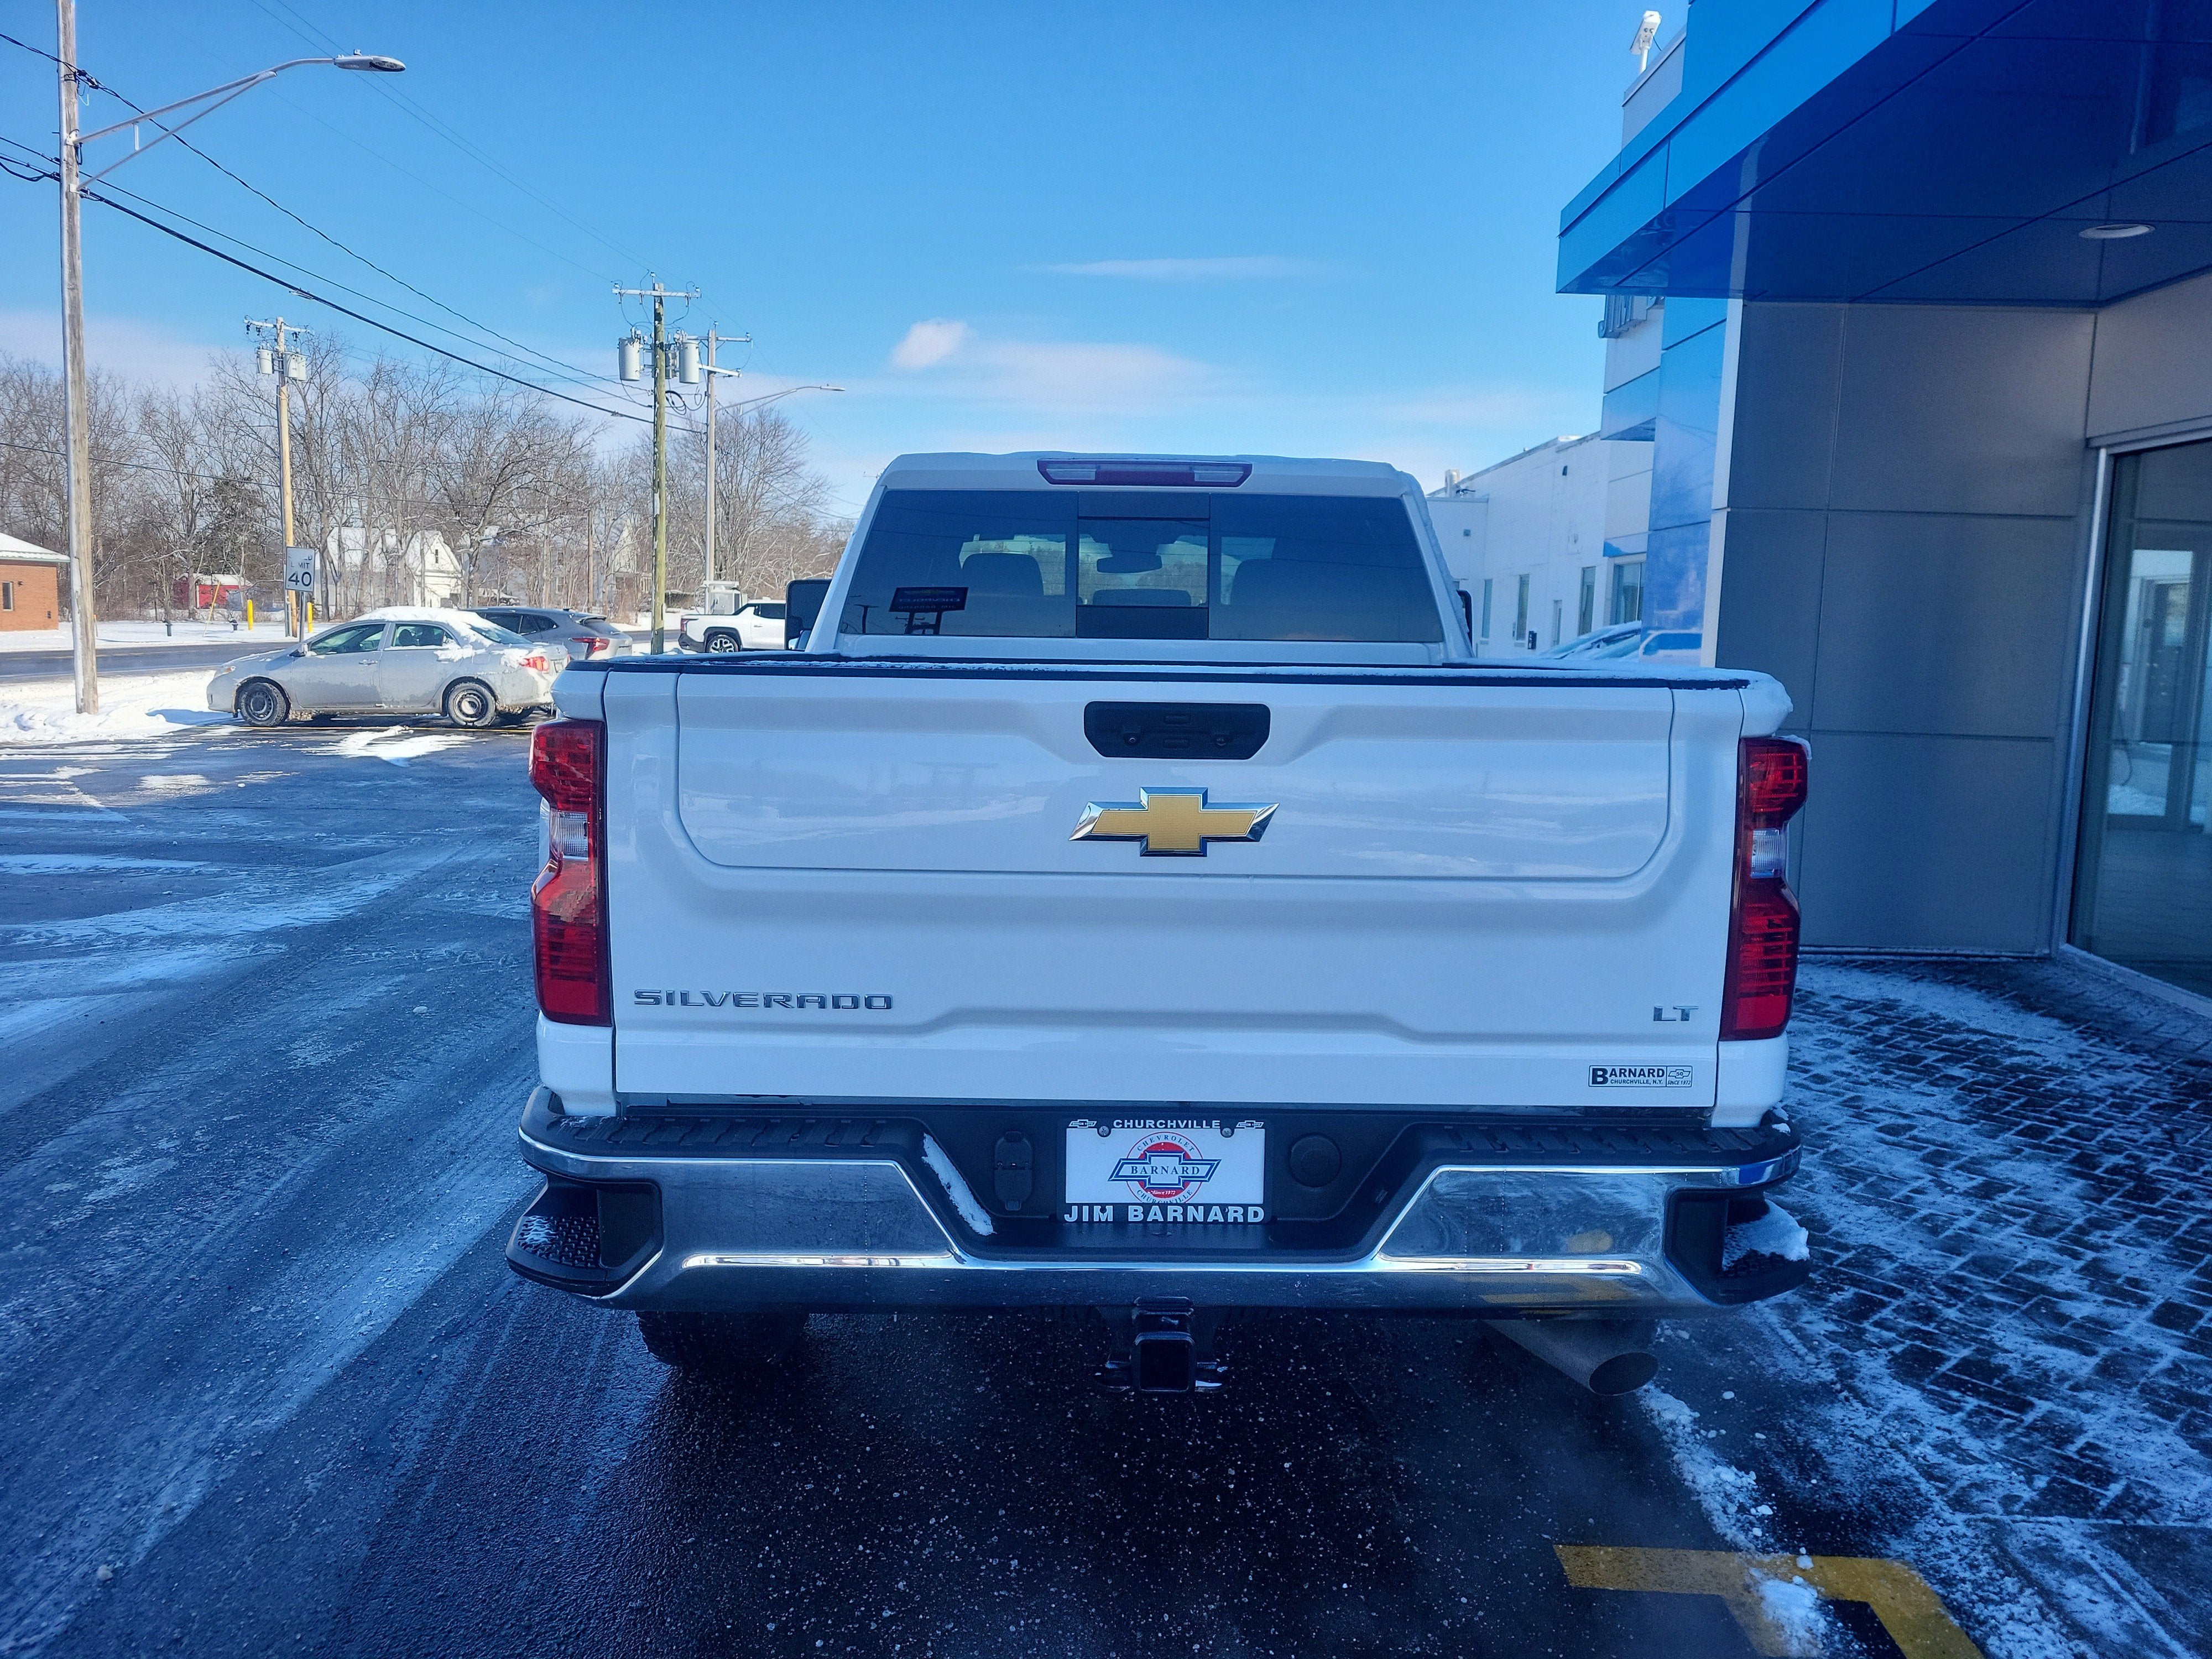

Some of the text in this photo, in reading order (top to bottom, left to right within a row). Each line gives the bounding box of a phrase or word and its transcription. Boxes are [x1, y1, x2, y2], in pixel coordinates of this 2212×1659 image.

[288, 571, 312, 586] 40
[634, 989, 893, 1010] SILVERADO
[1653, 1005, 1699, 1021] LT
[1592, 1068, 1665, 1084] BARNARD
[1113, 1119, 1220, 1128] CHURCHVILLE
[1137, 1134, 1194, 1151] CHEVROLET
[1131, 1166, 1200, 1175] BARNARD
[1065, 1206, 1264, 1223] JIM BARNARD
